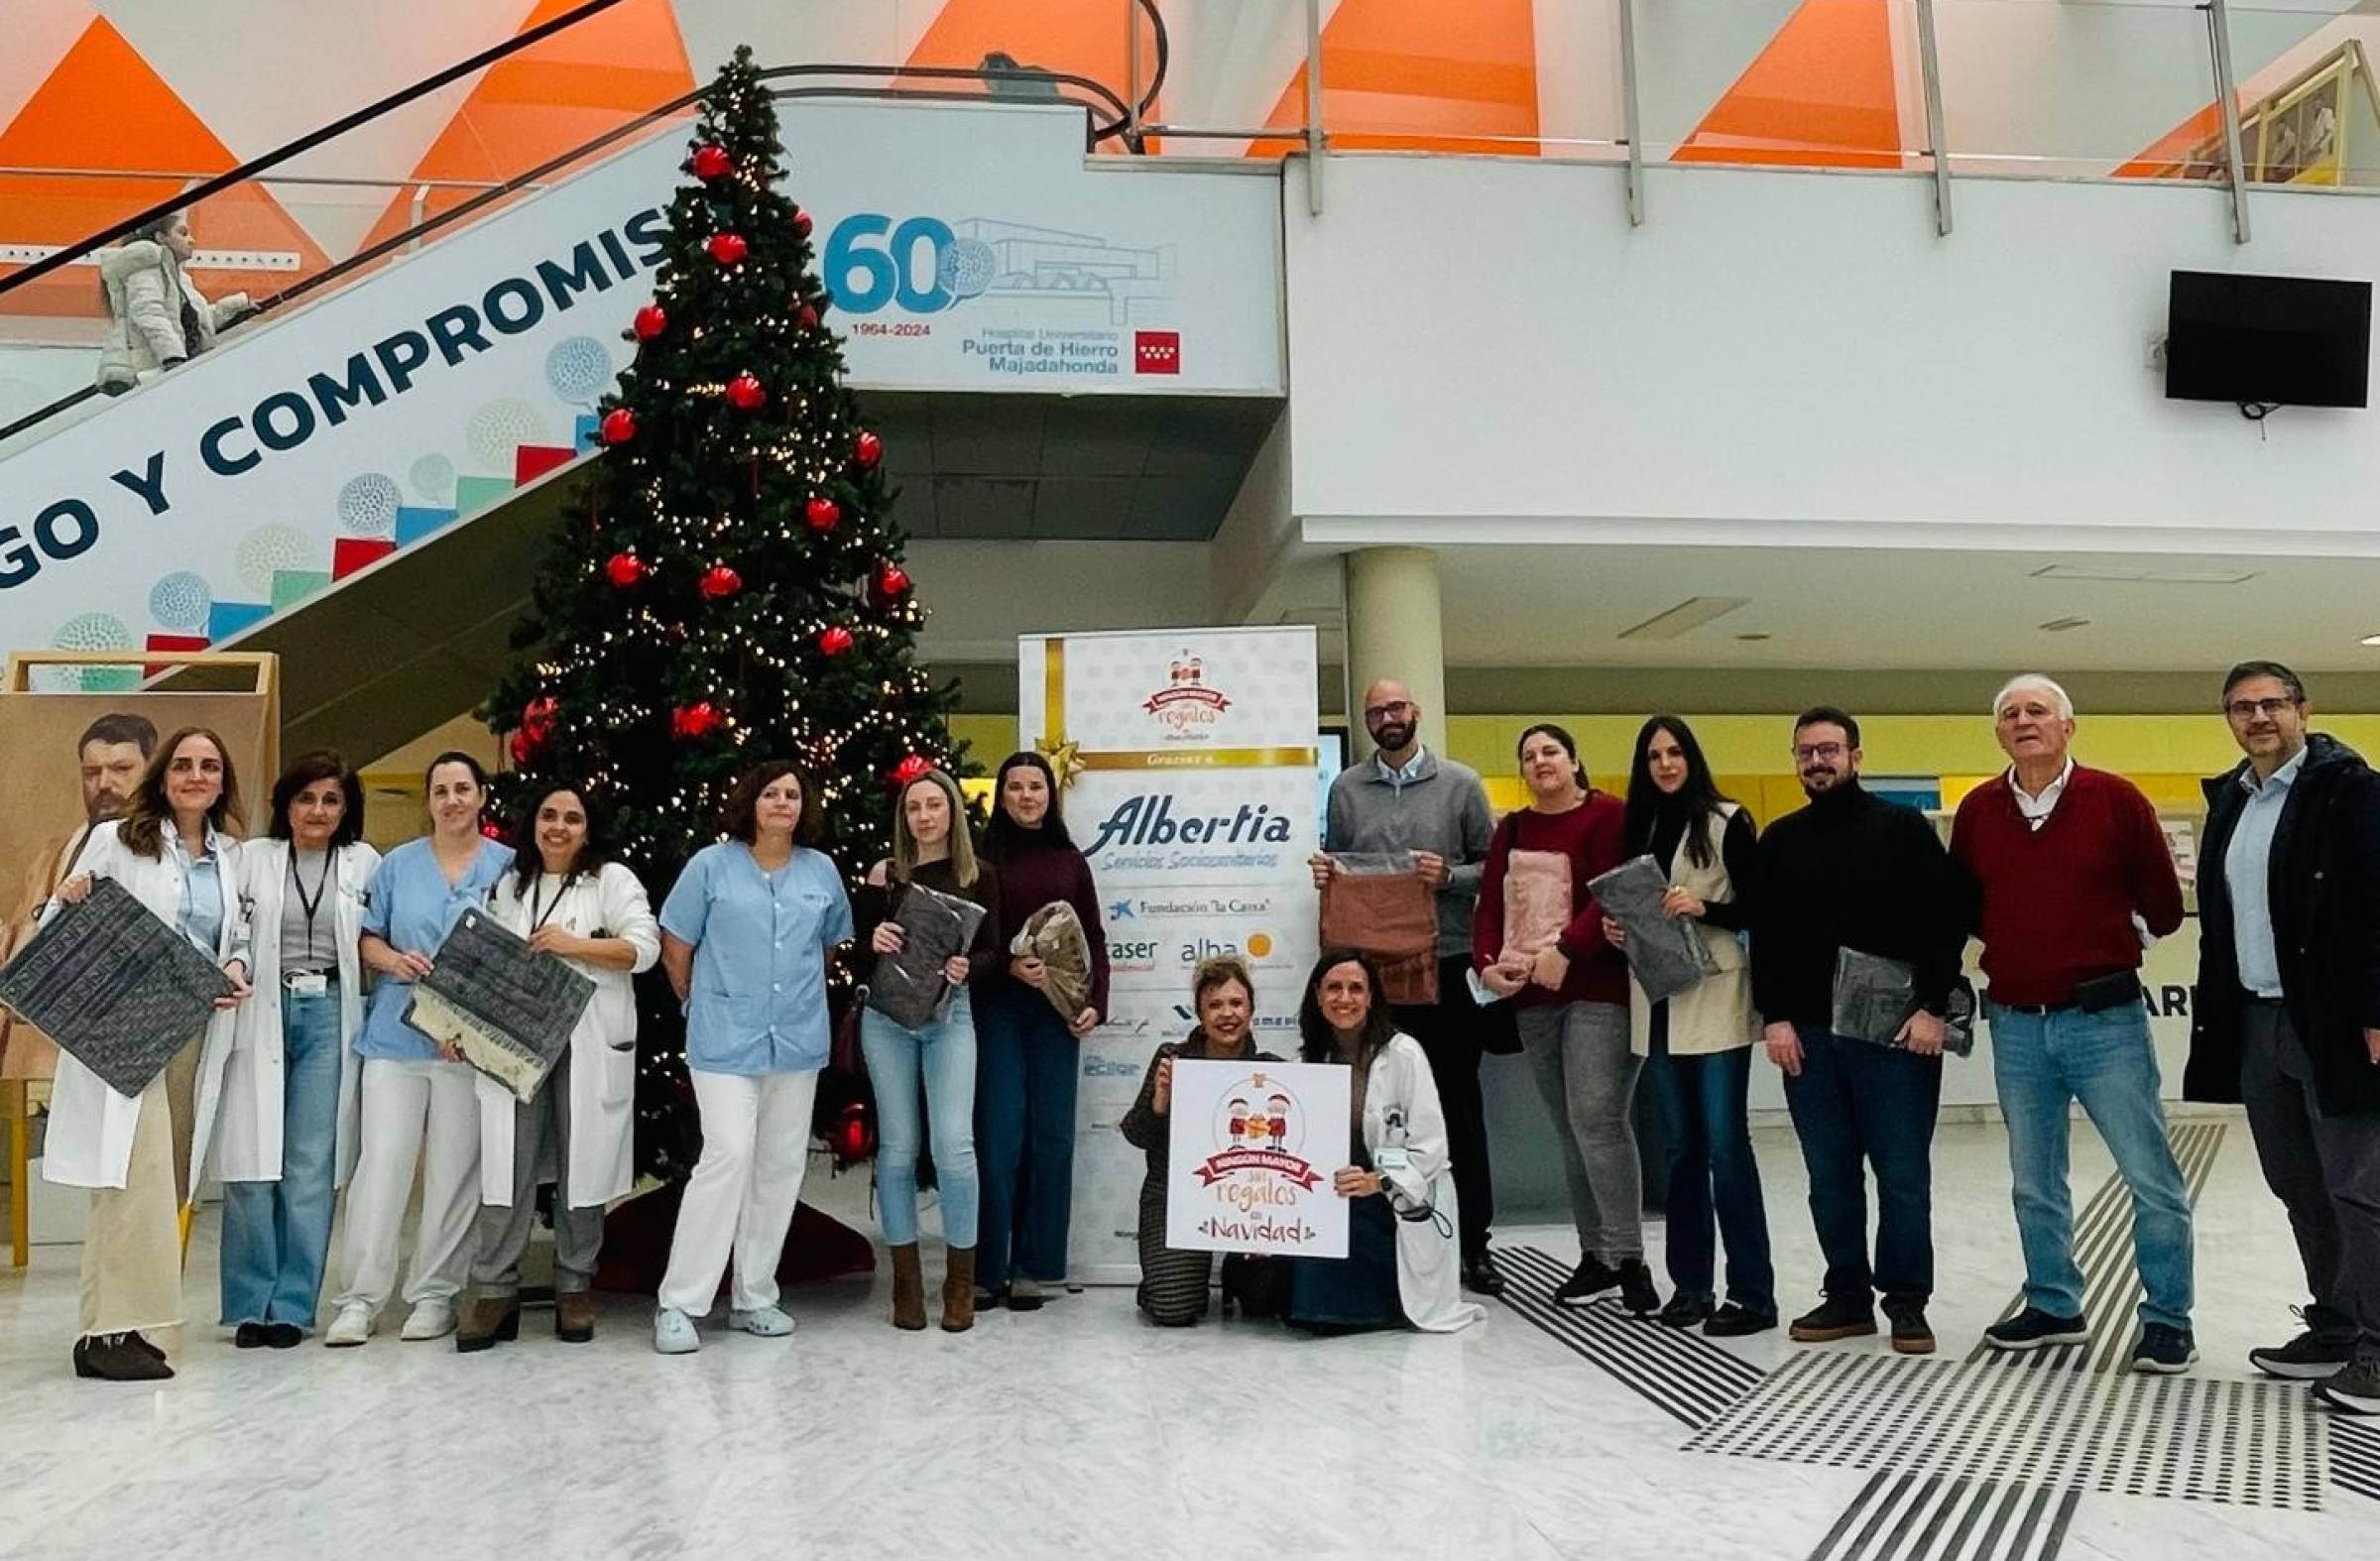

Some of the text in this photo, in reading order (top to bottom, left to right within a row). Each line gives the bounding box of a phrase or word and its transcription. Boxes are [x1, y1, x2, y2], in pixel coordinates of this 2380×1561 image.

[823, 213, 958, 315] 60
[852, 323, 931, 337] 1964-2024
[109, 450, 170, 515] Y
[199, 208, 675, 476] COMPROMIS
[963, 339, 1119, 358] Puerta de Hierro
[989, 357, 1119, 374] Majadahonda
[1085, 794, 1290, 857] Albertia
[1217, 1178, 1297, 1213] regalos
[1211, 1215, 1301, 1244] Navidad
